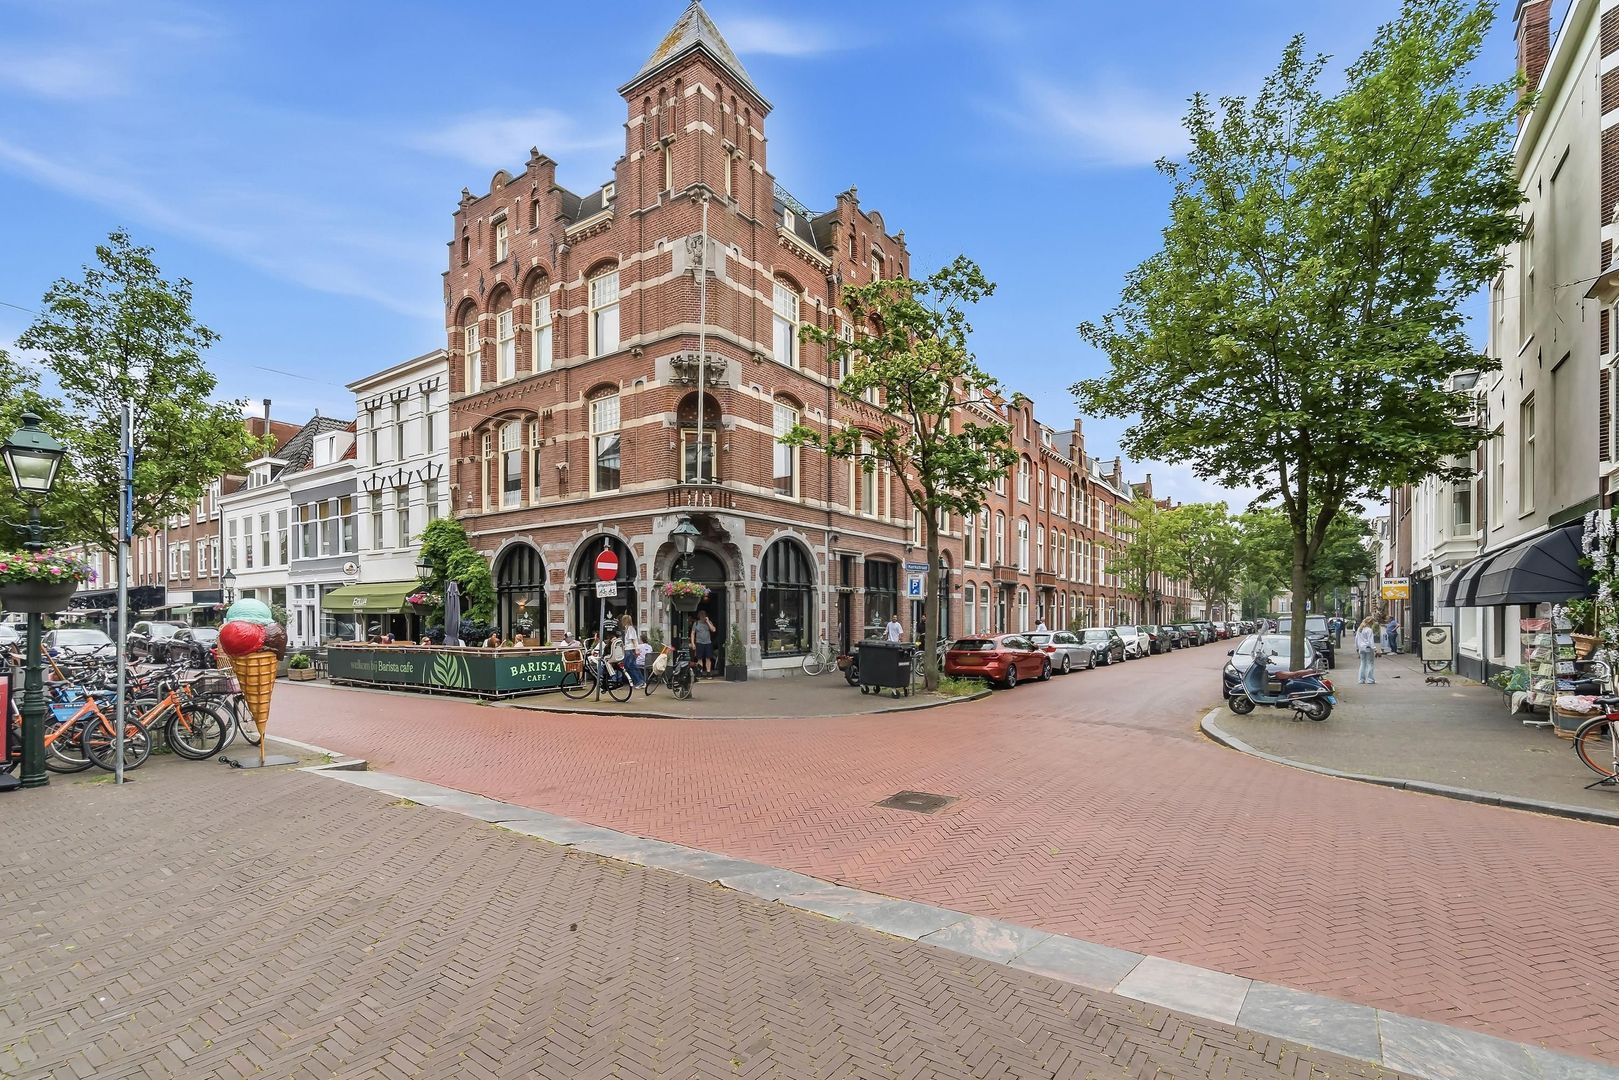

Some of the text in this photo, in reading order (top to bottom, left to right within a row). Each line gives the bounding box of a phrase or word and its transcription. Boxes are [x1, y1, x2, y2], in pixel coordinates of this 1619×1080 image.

[378, 660, 399, 672] Barista
[400, 661, 413, 673] cafe
[510, 661, 562, 676] BARISTA
